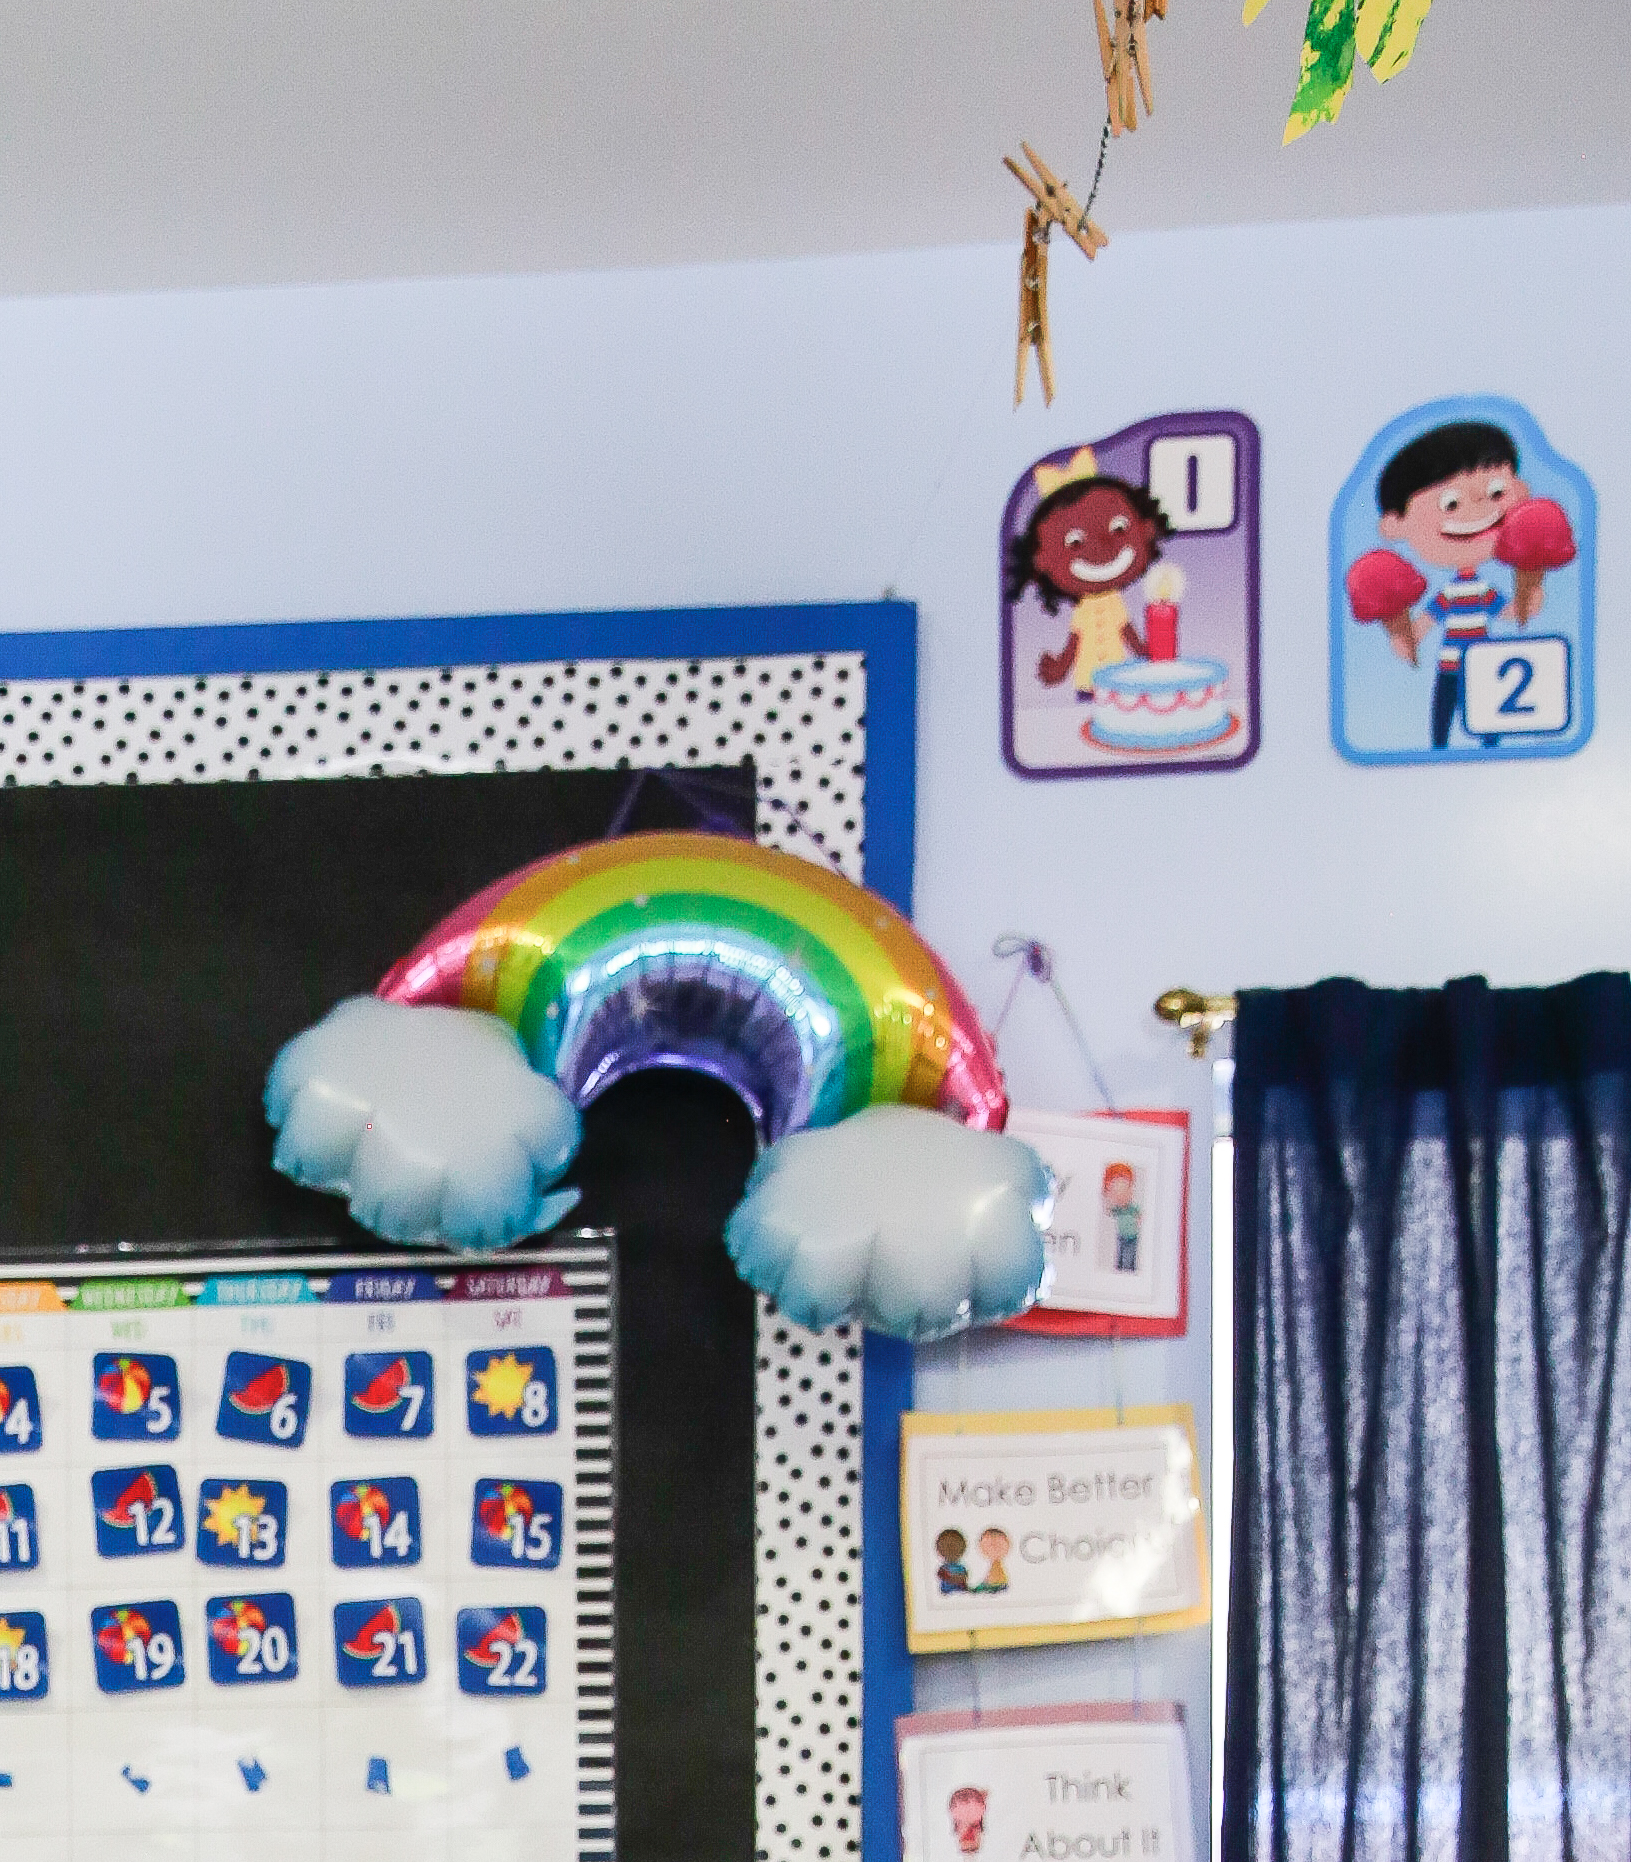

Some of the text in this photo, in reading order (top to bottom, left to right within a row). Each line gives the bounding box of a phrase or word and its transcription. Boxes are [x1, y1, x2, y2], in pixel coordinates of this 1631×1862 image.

[1495, 656, 1536, 716] 2
[4, 1398, 35, 1445] 4
[146, 1387, 172, 1434] 5
[270, 1393, 298, 1439] 6
[399, 1385, 424, 1431] 7
[521, 1380, 548, 1427] 8
[938, 1471, 1154, 1507] Make Better
[129, 1497, 176, 1546] 12
[232, 1514, 278, 1560] 13
[363, 1511, 411, 1558] 14
[510, 1513, 552, 1560] 15
[1020, 1530, 1159, 1564] Choic
[126, 1633, 176, 1681] 19
[237, 1625, 289, 1674] 20
[372, 1630, 417, 1677] 21
[486, 1639, 537, 1686] 22
[1044, 1771, 1132, 1803] Think
[1019, 1827, 1159, 1860] About It
